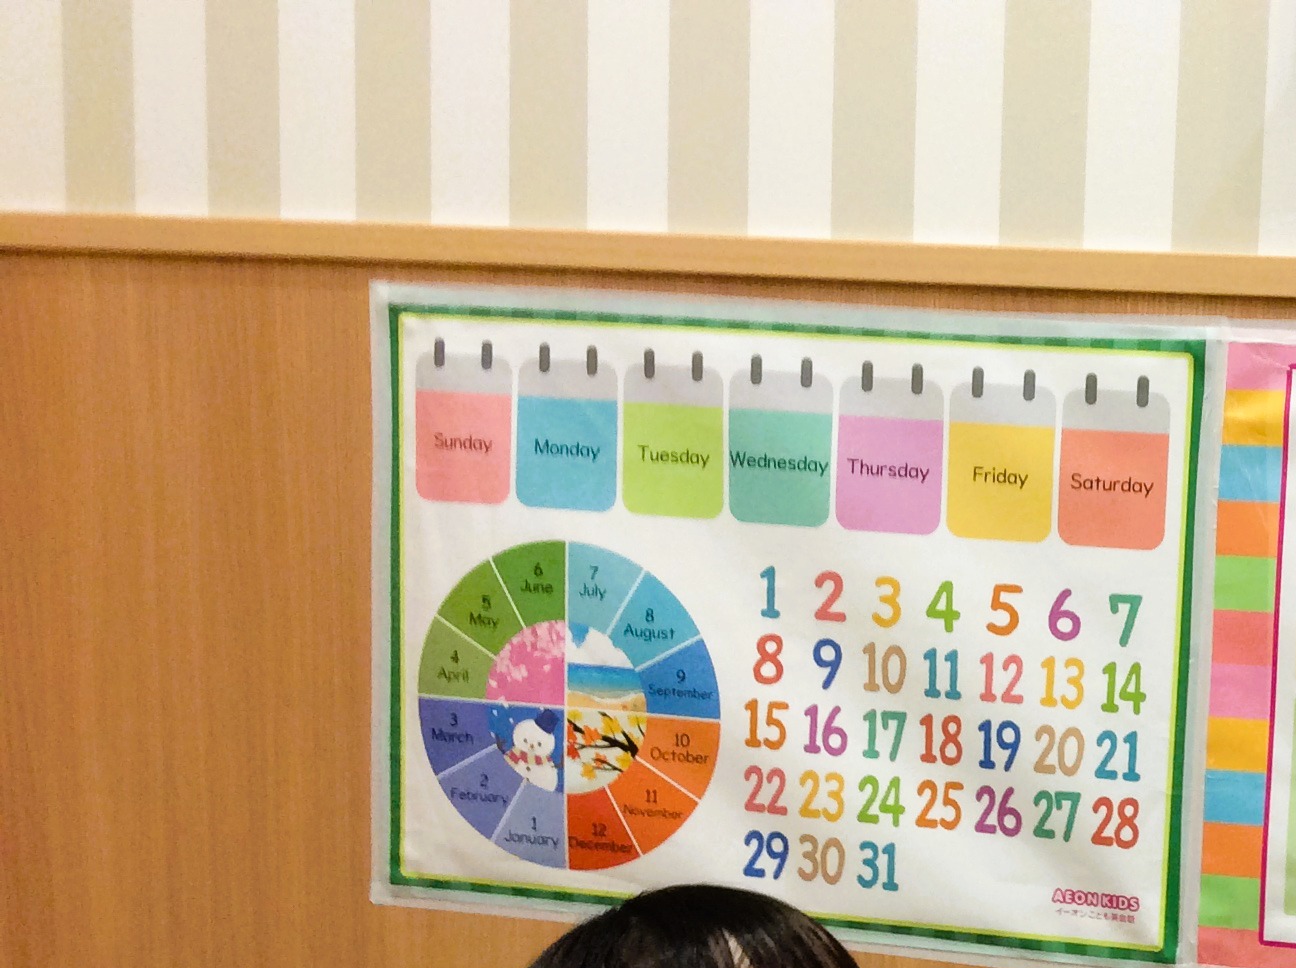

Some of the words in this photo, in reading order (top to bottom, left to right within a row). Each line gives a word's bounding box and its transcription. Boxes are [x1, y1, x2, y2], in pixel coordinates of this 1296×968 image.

[434, 433, 492, 453] Sunday
[534, 438, 600, 461] Monday
[638, 444, 710, 468] Tuesday
[730, 451, 829, 475] Wednesday
[847, 458, 930, 483] Thursday
[972, 466, 1029, 489] Friday
[1071, 473, 1154, 497] Saturday
[533, 562, 544, 577] 6
[589, 565, 599, 581] 7
[520, 580, 554, 595] June
[578, 583, 607, 601] July
[481, 595, 491, 609] 5
[760, 565, 780, 619] 1
[813, 570, 846, 623] 2
[871, 575, 901, 628] 3
[926, 580, 960, 633] 4
[985, 583, 1023, 636] 5
[1048, 587, 1081, 641] 6
[1108, 592, 1143, 648] 7
[469, 611, 499, 629] May
[645, 608, 655, 622] 8
[624, 623, 675, 642] August
[450, 650, 460, 664] 4
[437, 667, 469, 684] April
[676, 669, 686, 684] 9
[752, 633, 785, 685] 8
[812, 637, 843, 690] 9
[862, 641, 907, 694] 10
[923, 647, 962, 700] 11
[979, 652, 1024, 704] 12
[1039, 656, 1085, 710] 13
[1101, 661, 1147, 715] 14
[648, 684, 714, 702] September
[449, 713, 459, 727] 3
[431, 727, 474, 745] March
[674, 733, 690, 748] 10
[744, 698, 789, 751] 15
[803, 704, 848, 756] 16
[862, 708, 907, 762] 17
[918, 713, 963, 766] 18
[978, 719, 1021, 771] 19
[1033, 724, 1085, 777] 20
[1094, 730, 1141, 782] 21
[650, 747, 709, 764] October
[480, 774, 489, 788] 2
[450, 787, 509, 804] February
[645, 789, 658, 804] 11
[623, 804, 683, 820] November
[743, 765, 788, 816] 22
[798, 769, 845, 822] 23
[857, 774, 905, 827] 24
[915, 779, 964, 830] 25
[974, 785, 1023, 837] 26
[1033, 790, 1081, 842] 27
[1091, 796, 1140, 850] 28
[531, 817, 538, 831] 1
[591, 823, 607, 837] 12
[504, 829, 559, 848] January
[568, 836, 633, 854] December
[743, 830, 789, 880] 29
[797, 833, 846, 885] 30
[857, 840, 899, 892] 31
[1052, 887, 1098, 907] AEON
[1100, 893, 1140, 912] KIDS
